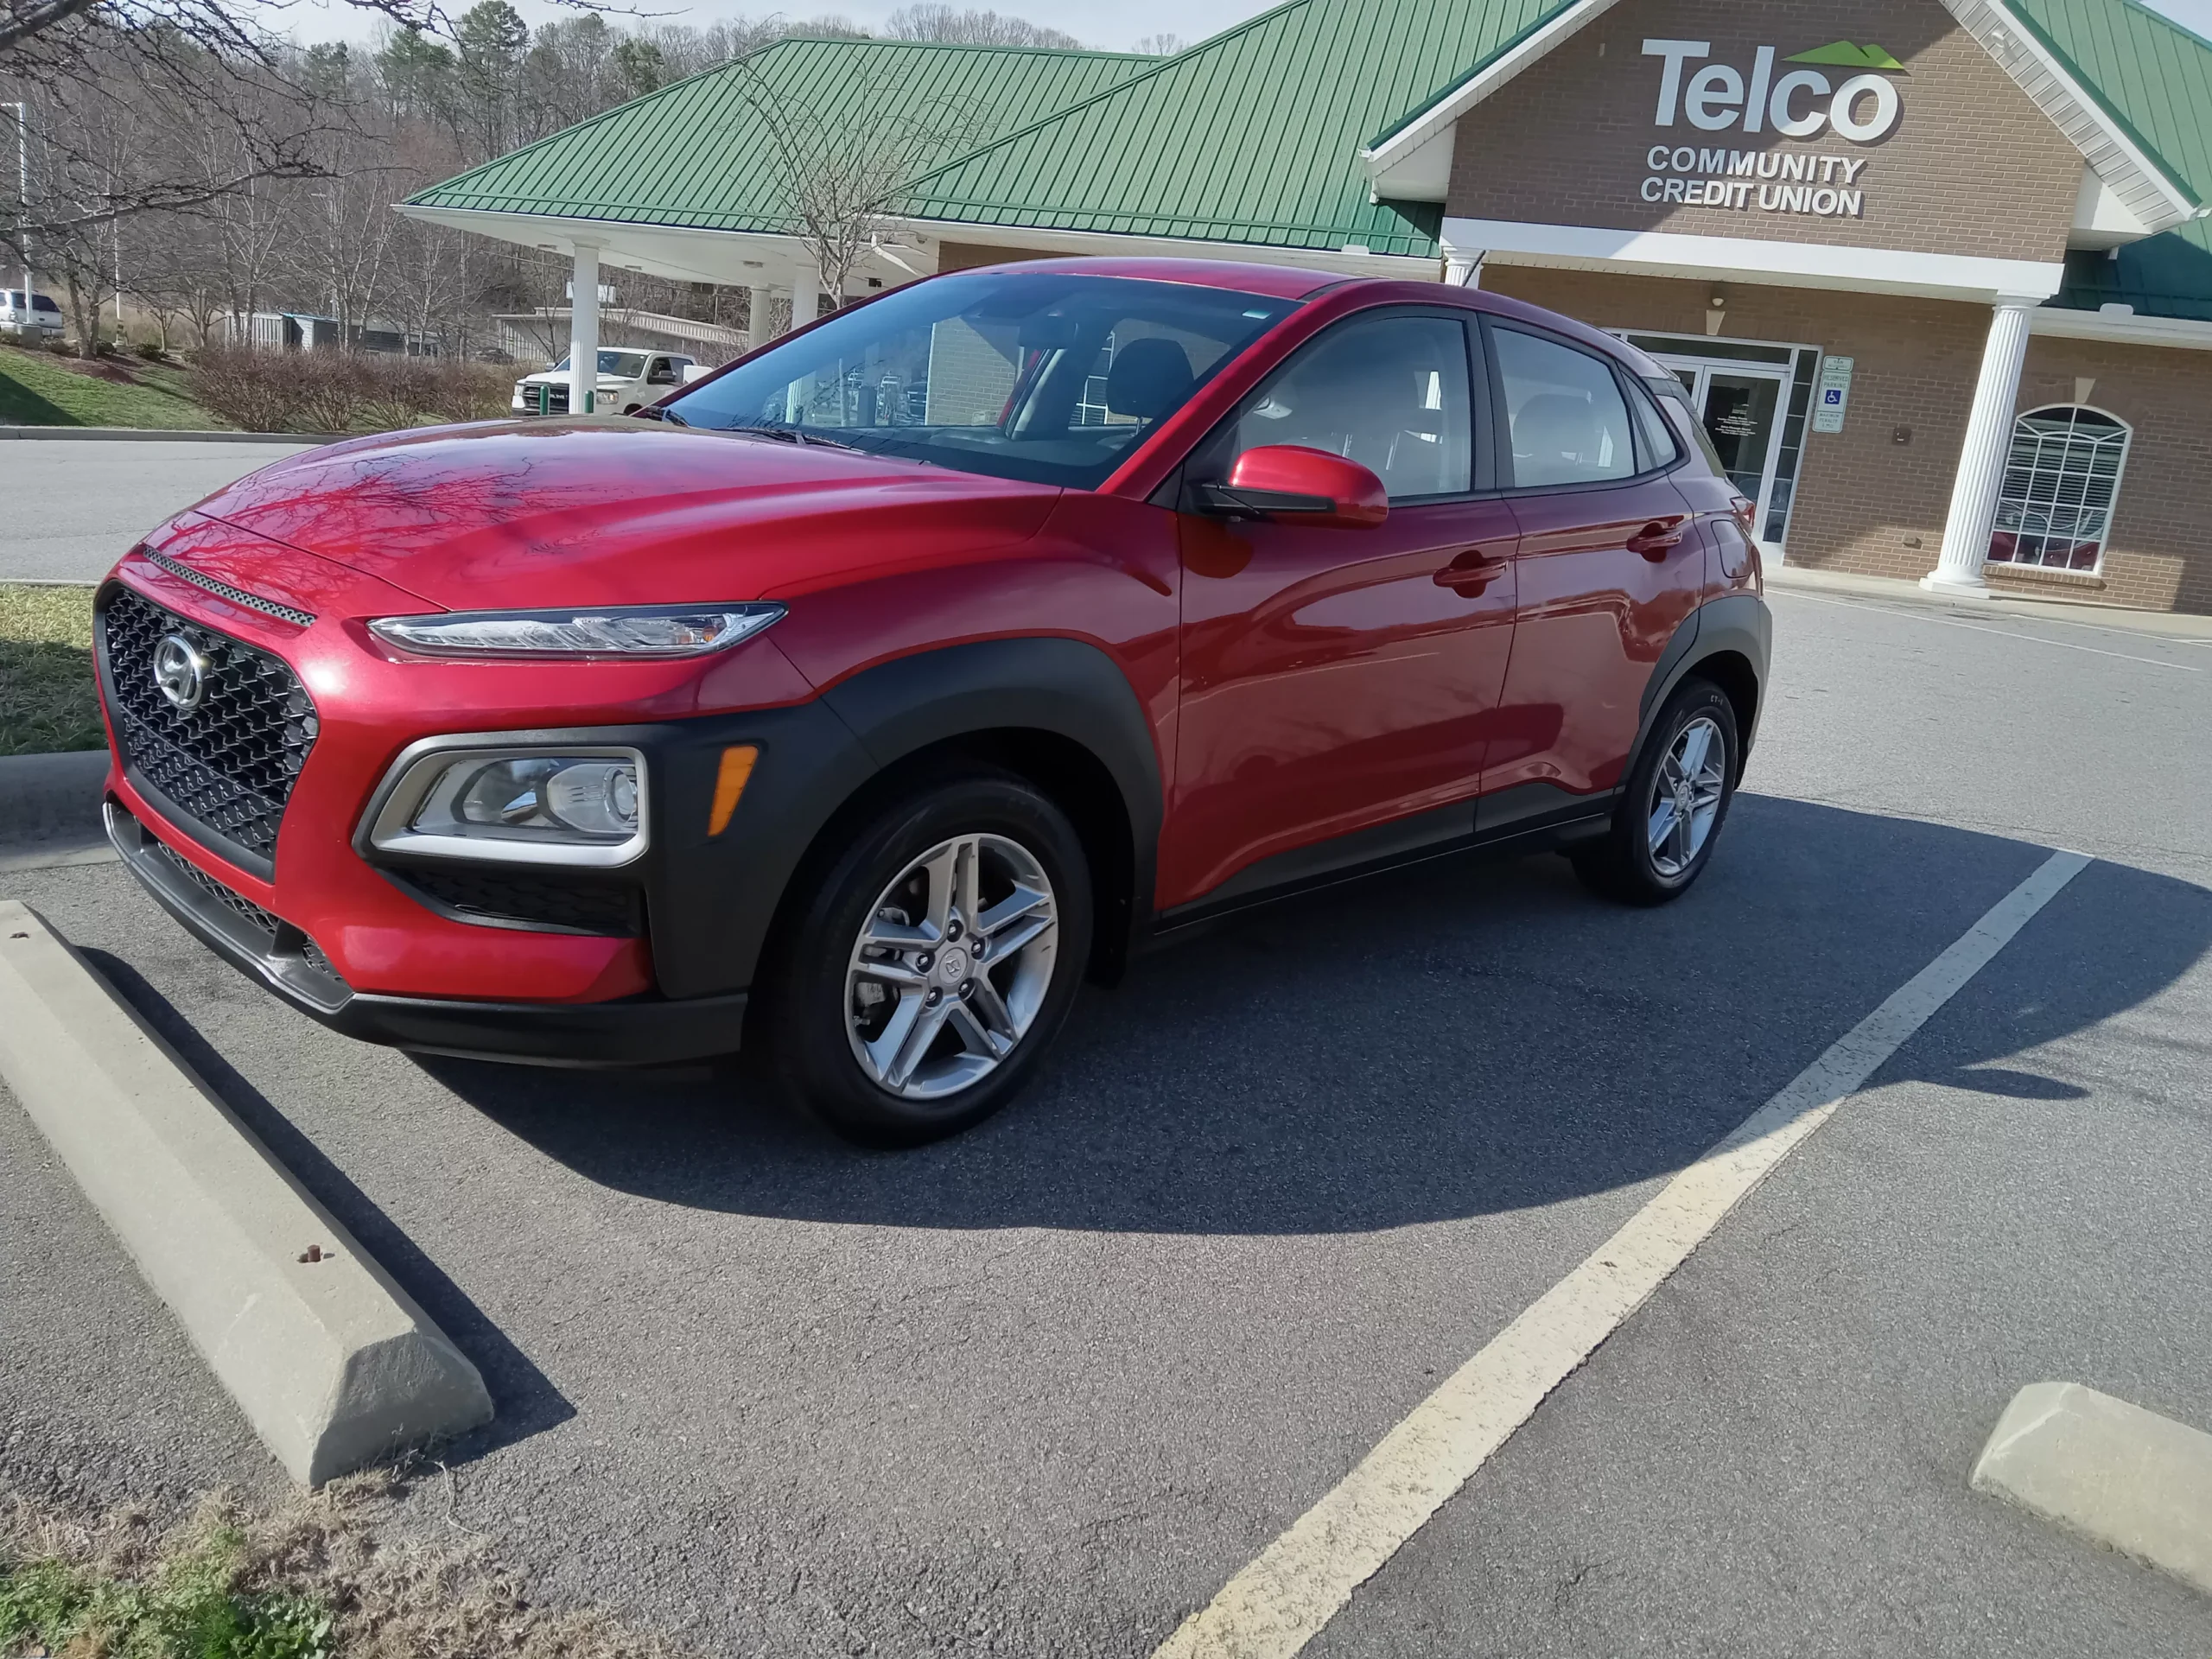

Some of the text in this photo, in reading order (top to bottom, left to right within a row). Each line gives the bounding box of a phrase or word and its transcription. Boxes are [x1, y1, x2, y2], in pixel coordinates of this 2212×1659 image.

[1641, 39, 1899, 142] Telco
[1646, 145, 1866, 184] COMMUNITY
[1641, 176, 1862, 216] CREDIT UNION
